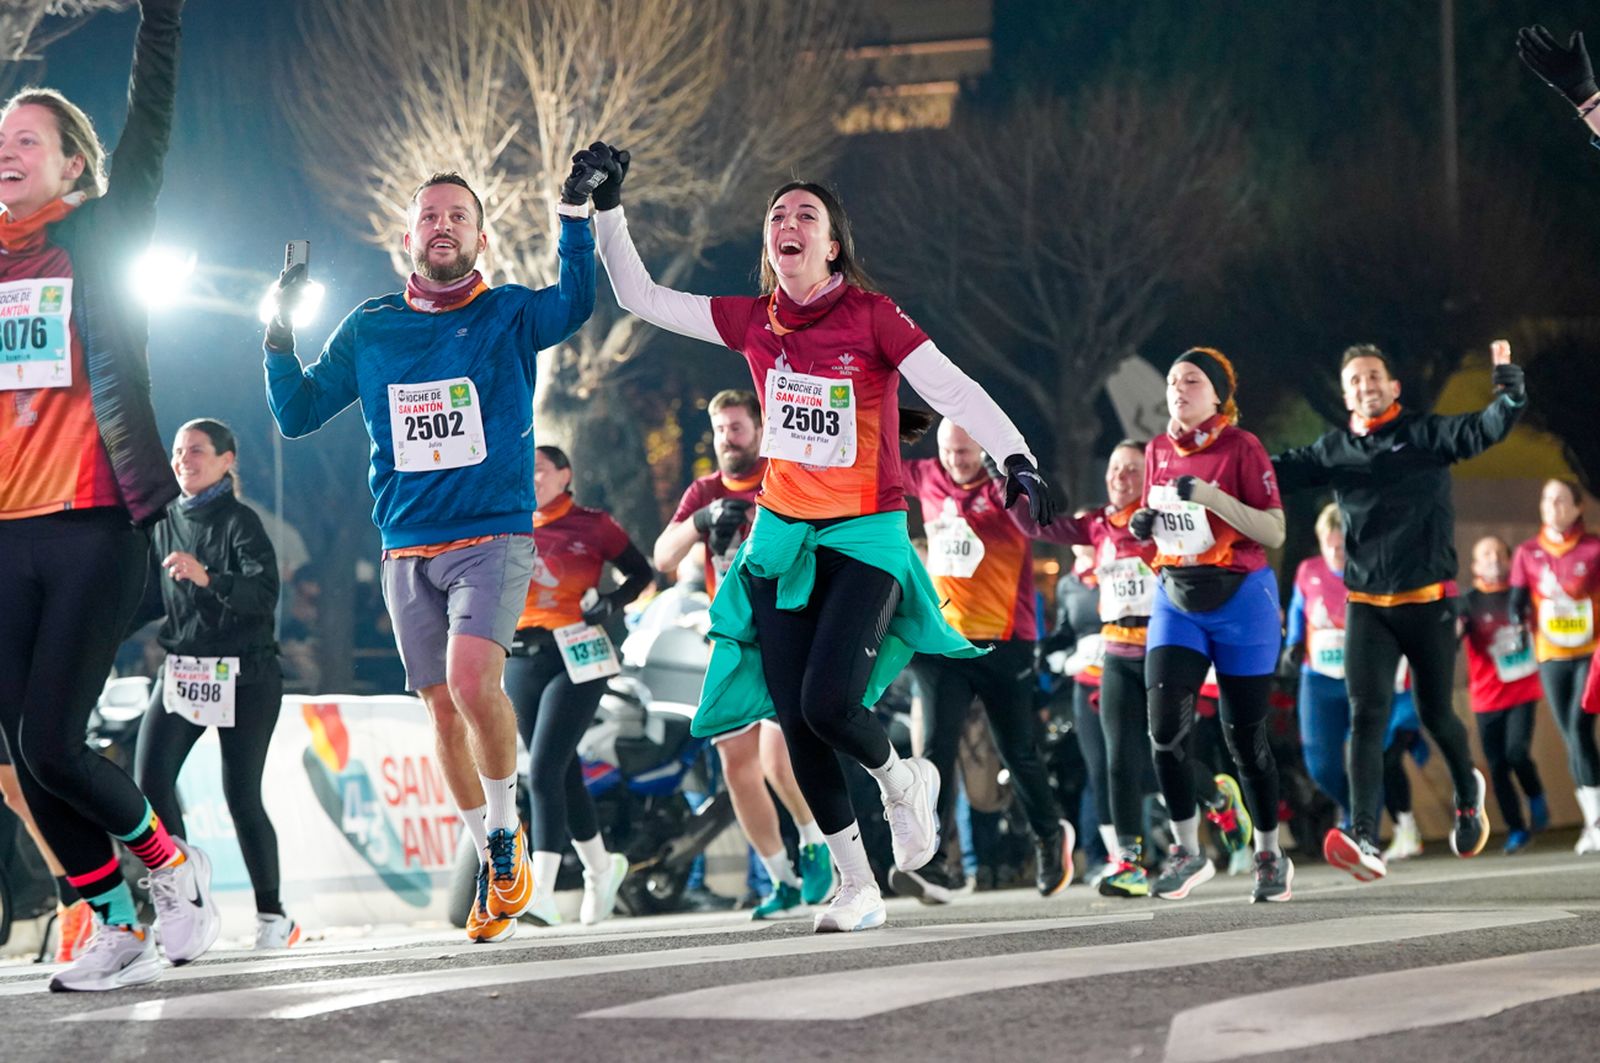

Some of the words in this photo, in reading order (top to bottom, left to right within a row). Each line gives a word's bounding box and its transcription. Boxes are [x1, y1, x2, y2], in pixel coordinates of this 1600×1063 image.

[0, 294, 20, 305] OCHE
[430, 391, 441, 400] DE
[775, 391, 794, 402] SAN
[787, 382, 812, 394] NOCHE
[813, 387, 823, 396] DE
[398, 405, 412, 414] SAN
[413, 400, 443, 414] ANTÓN
[404, 410, 465, 441] 2502
[781, 404, 840, 437] 2503
[1160, 512, 1195, 531] 1916
[1112, 579, 1145, 597] 1531
[177, 681, 222, 703] 5698
[382, 756, 445, 807] SAN
[402, 815, 464, 868] ANT
